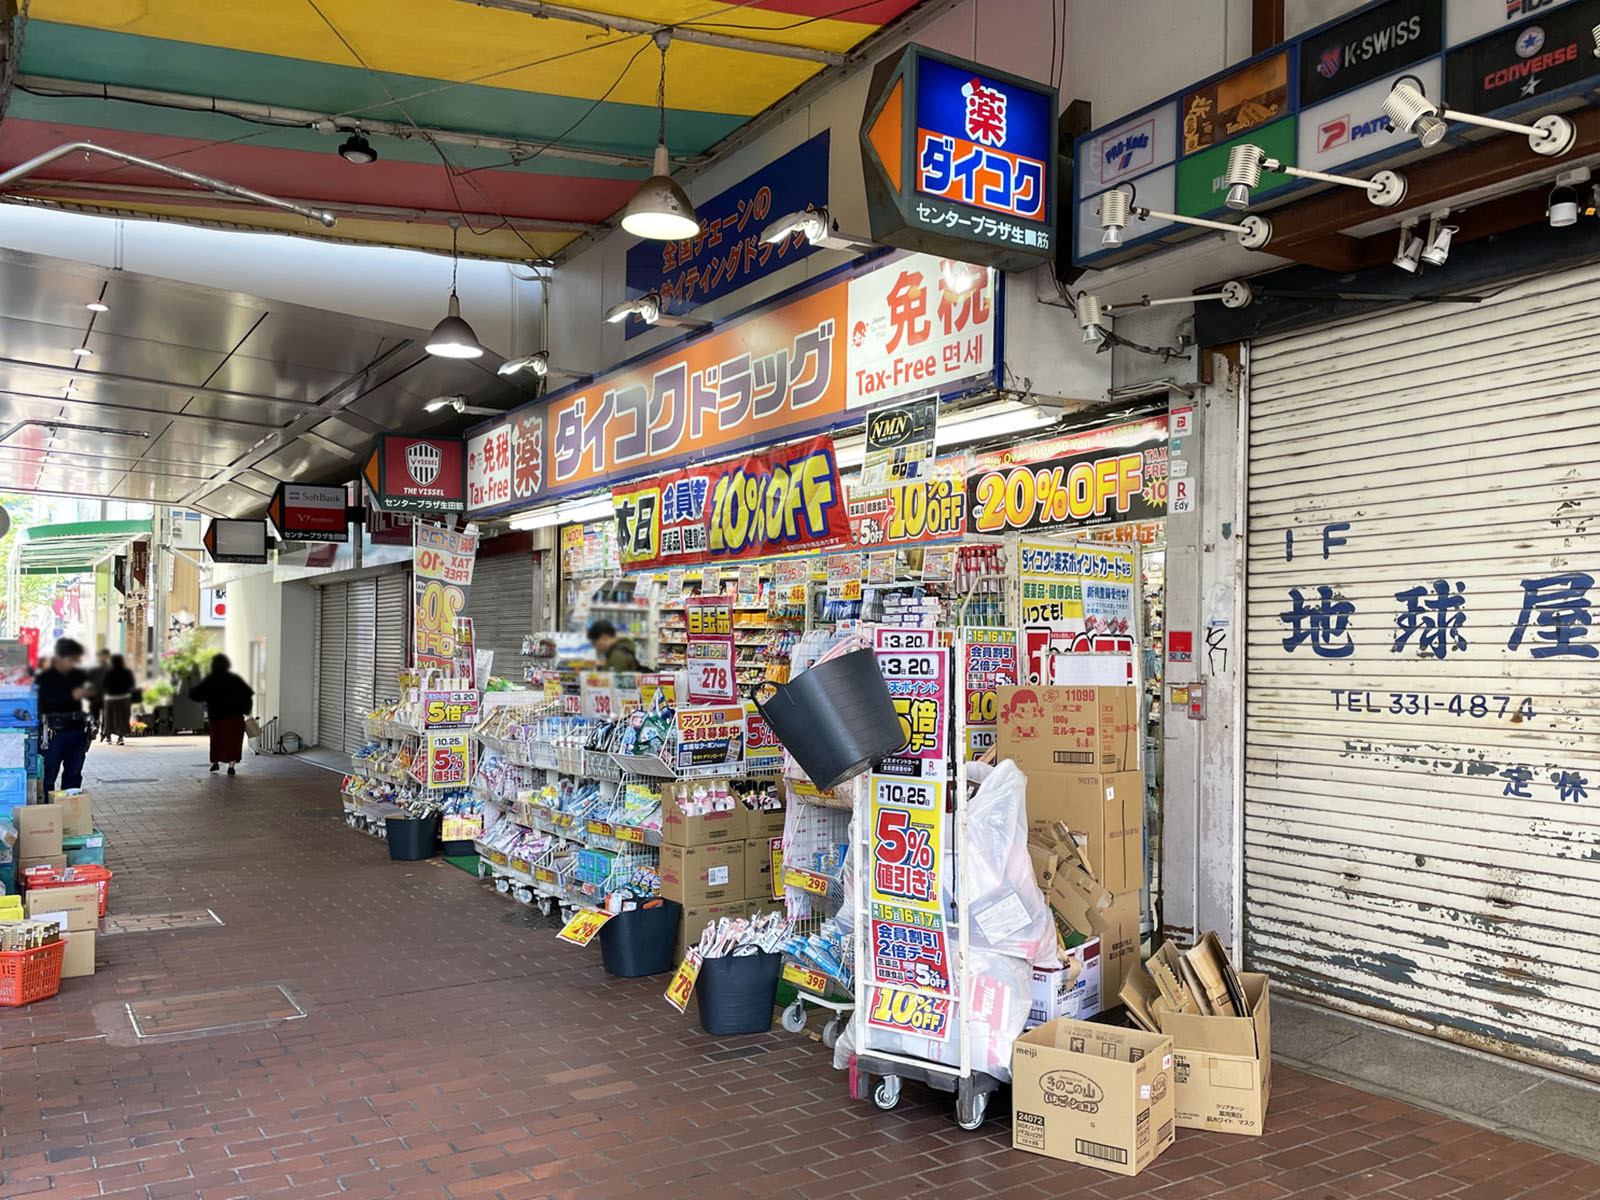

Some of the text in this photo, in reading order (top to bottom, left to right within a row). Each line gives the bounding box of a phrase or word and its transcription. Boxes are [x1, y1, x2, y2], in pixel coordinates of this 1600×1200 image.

[1483, 43, 1578, 91] CONVERSE
[964, 80, 1007, 147] 薬
[919, 136, 1044, 218] ダイコク
[856, 334, 983, 396] Tax-Free 면세
[555, 318, 835, 481] ダイコクドラッグ
[871, 415, 908, 441] NMN
[483, 431, 509, 475] 免税
[514, 416, 542, 498] 薬
[1144, 447, 1168, 462] TAX
[302, 491, 340, 502] SoftBank
[403, 487, 445, 497] THE VISSEL
[469, 478, 509, 505] Tax-Free
[976, 453, 1144, 533] 20%OFF
[385, 499, 464, 510] センタープラザ生田筋
[709, 453, 834, 553] 10%OFF
[926, 494, 964, 534] OFF
[1174, 501, 1189, 511] Edy
[614, 493, 656, 556] 本日
[870, 530, 884, 544] OFF
[1278, 572, 1600, 660] 地球屋
[971, 646, 1013, 659] 会員割引
[702, 667, 727, 690] 278
[885, 681, 940, 695] 天ポイント
[566, 697, 579, 713] 178
[1065, 689, 1095, 701] 11090
[1331, 690, 1537, 721] TEL 331-4874
[682, 714, 712, 727] アプリ
[683, 725, 741, 741] 会員募集中
[434, 750, 463, 771] 5%
[433, 769, 462, 783] 値引き
[877, 810, 931, 867] 5%
[807, 878, 827, 892] 298
[877, 862, 927, 897] 値引き
[878, 924, 939, 949] 会員割引
[673, 973, 693, 1000] 78
[806, 977, 826, 990] 398
[930, 976, 948, 989] OFF
[911, 1011, 941, 1033] OFF
[1016, 1047, 1037, 1058] meiji
[1047, 1075, 1096, 1099] きのこの山
[1215, 1103, 1245, 1111] クリアターン
[1018, 1112, 1044, 1125] 24072
